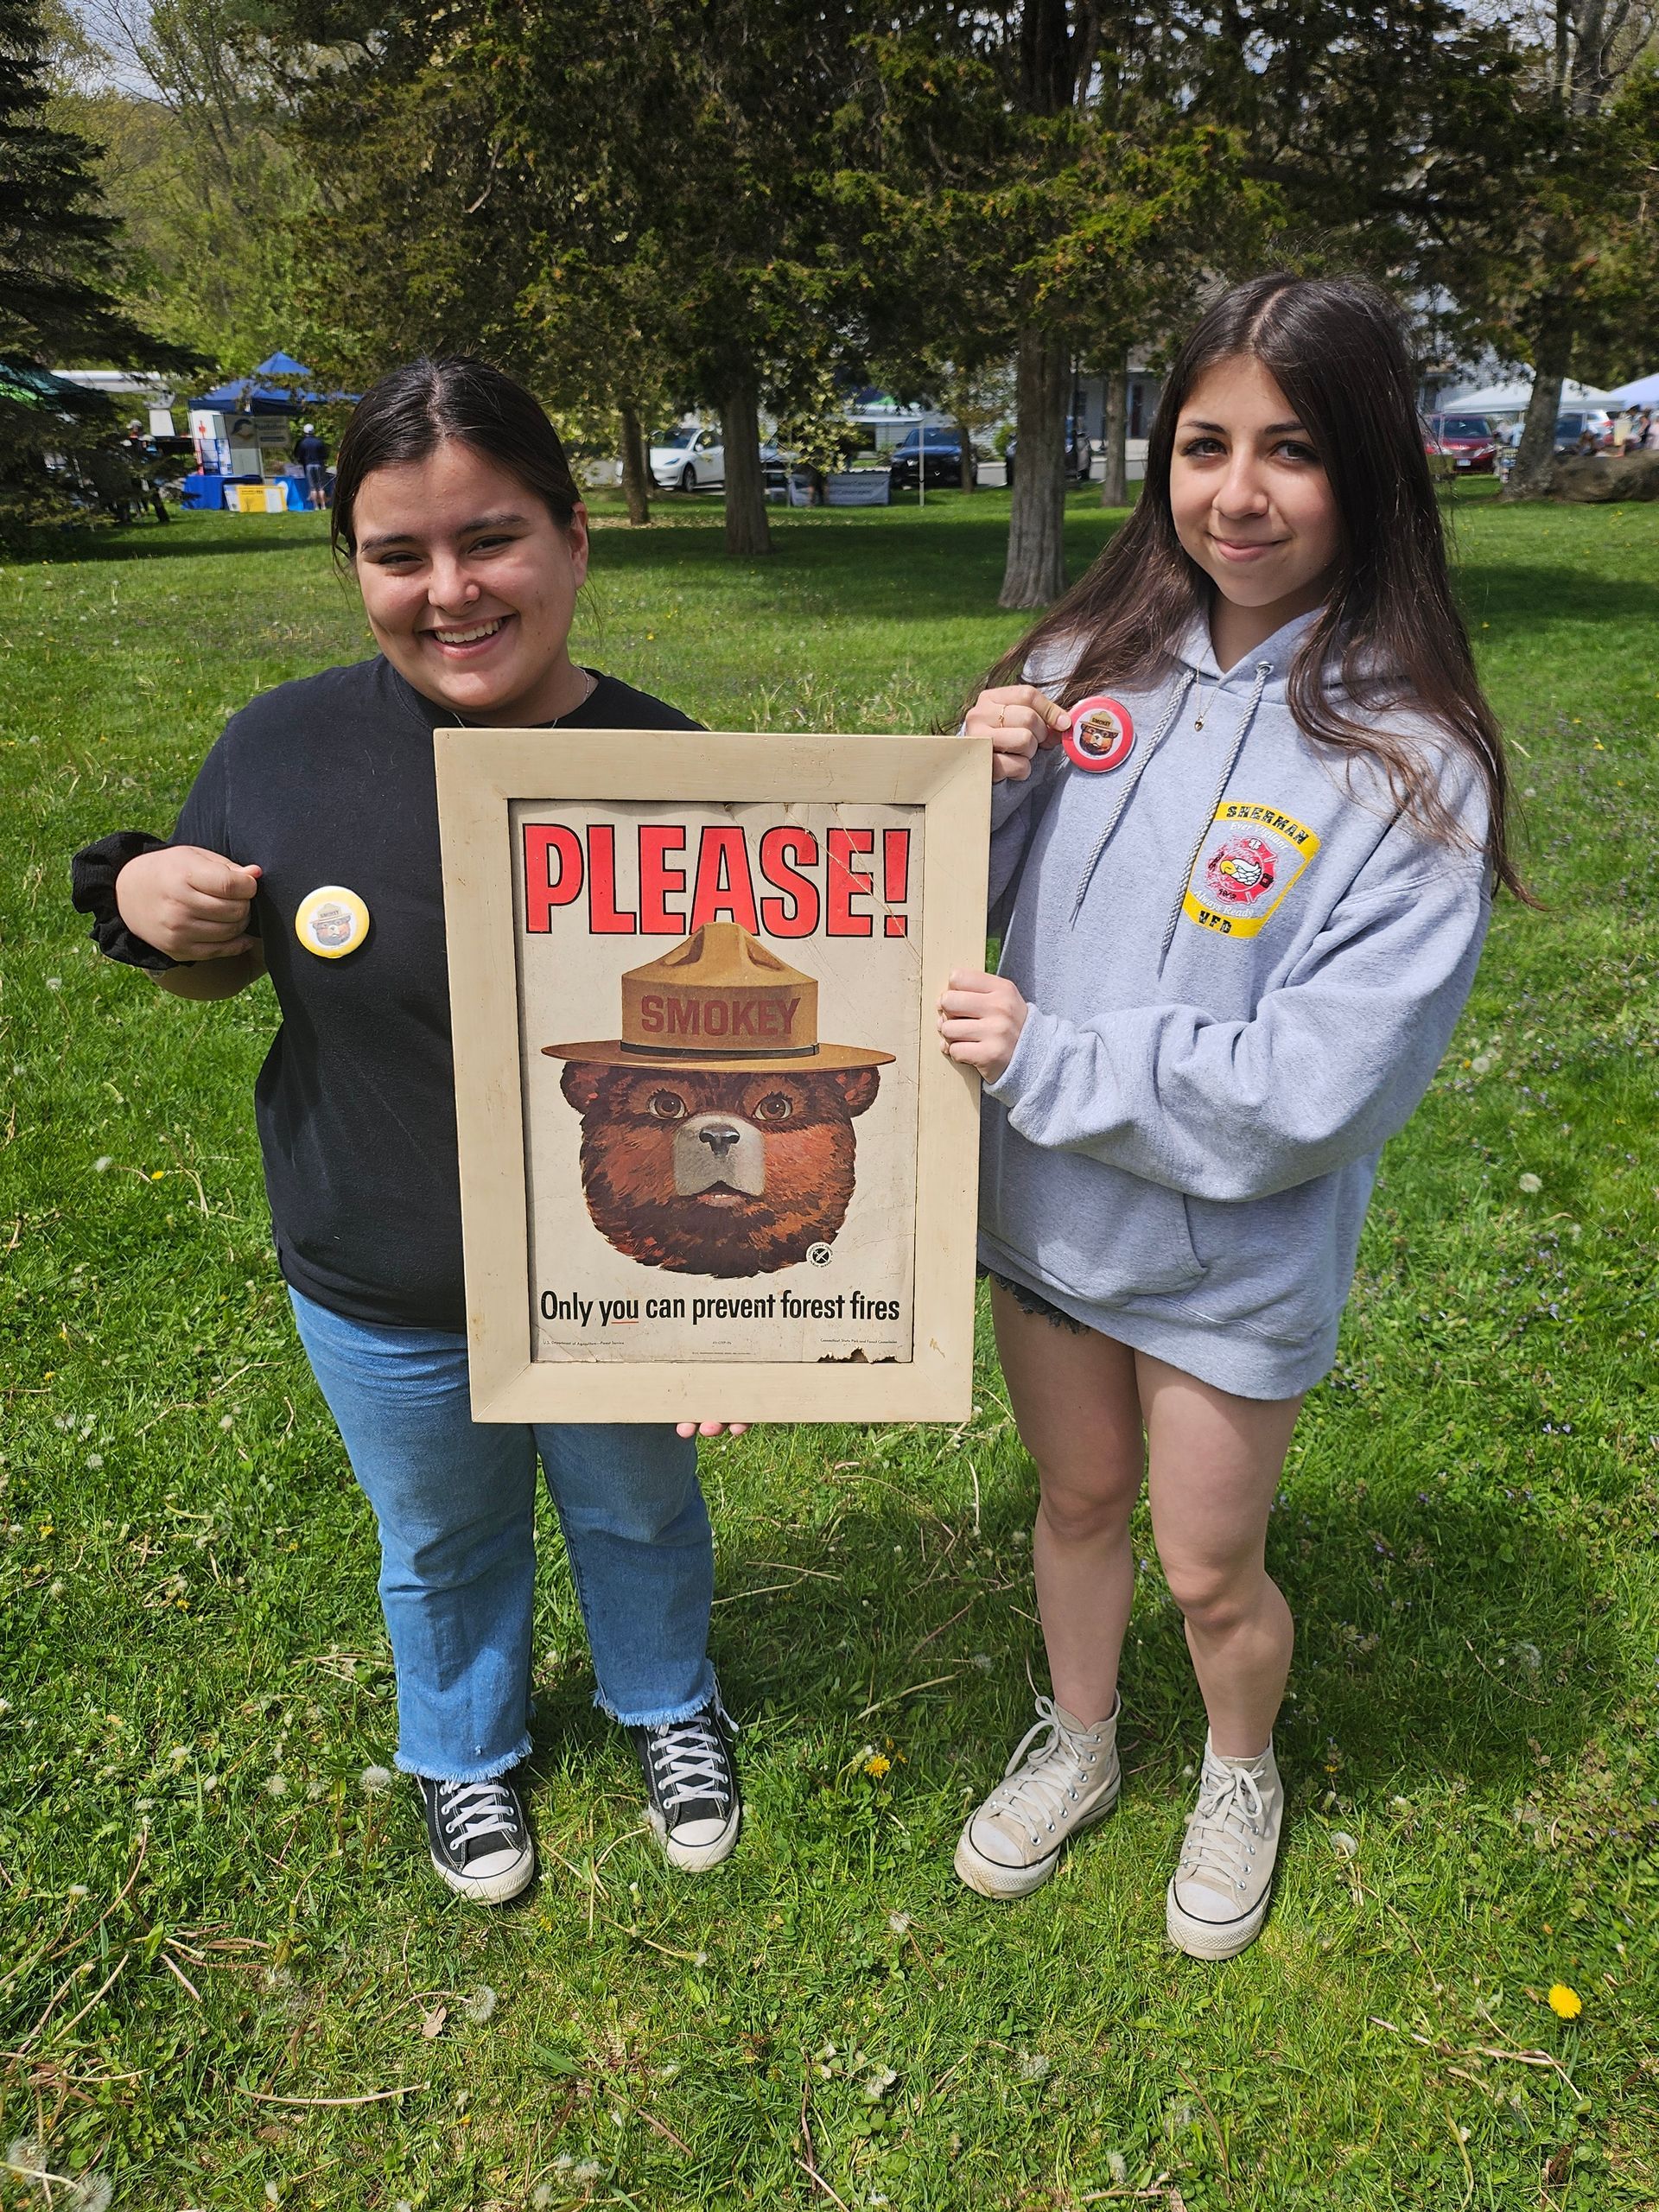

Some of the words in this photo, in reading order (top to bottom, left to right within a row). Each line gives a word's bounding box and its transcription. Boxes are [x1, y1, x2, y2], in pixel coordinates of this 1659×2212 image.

[1226, 805, 1310, 846] SHERMAN
[1230, 822, 1253, 832] Ever
[1255, 823, 1290, 850] Vigilant
[522, 823, 912, 938] PLEASE!
[1193, 889, 1222, 913] Always
[1223, 905, 1255, 918] Ready
[1198, 910, 1232, 934] VFD
[640, 994, 802, 1037] SMOKEY
[540, 1290, 594, 1327] Only
[601, 1298, 639, 1326] you
[645, 1295, 685, 1319] can
[692, 1294, 776, 1325] prevent
[780, 1289, 845, 1319] forest
[850, 1290, 900, 1320] fires
